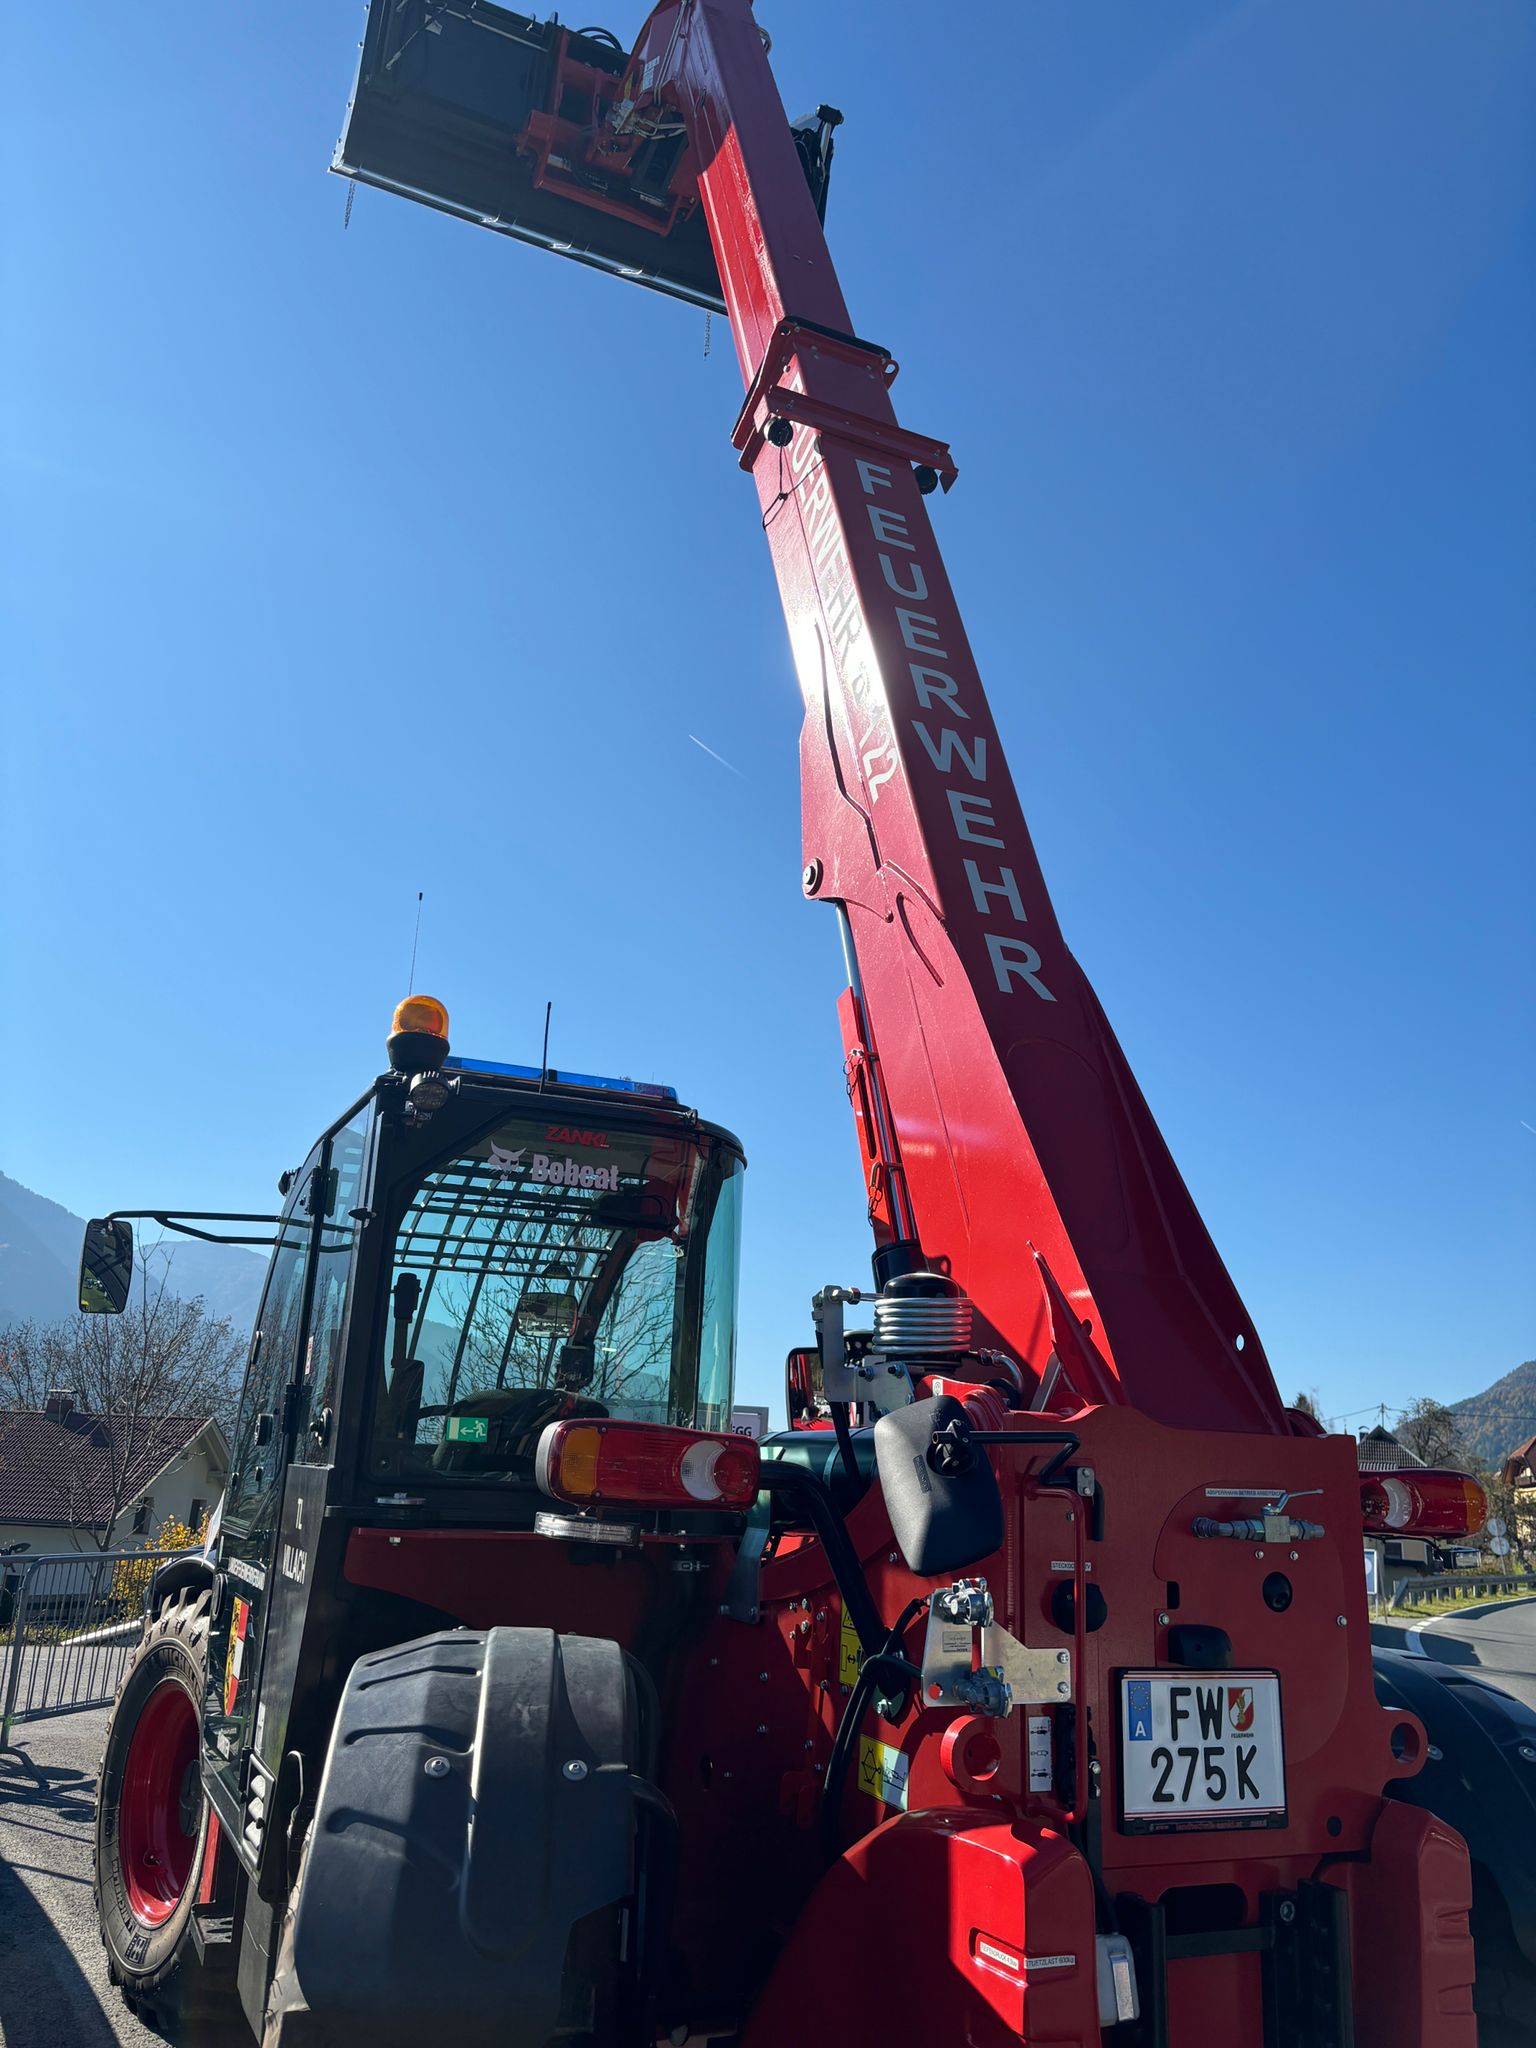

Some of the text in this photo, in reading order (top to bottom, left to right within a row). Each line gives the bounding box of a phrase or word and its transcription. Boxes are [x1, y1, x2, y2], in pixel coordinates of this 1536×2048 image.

[855, 458, 1057, 1002] FEUERWEHR
[544, 1125, 610, 1148] ZANKL
[531, 1153, 620, 1191] Bobcat
[282, 1543, 308, 1585] VILLACH
[1135, 1721, 1146, 1737] A
[1170, 1686, 1223, 1741] FW
